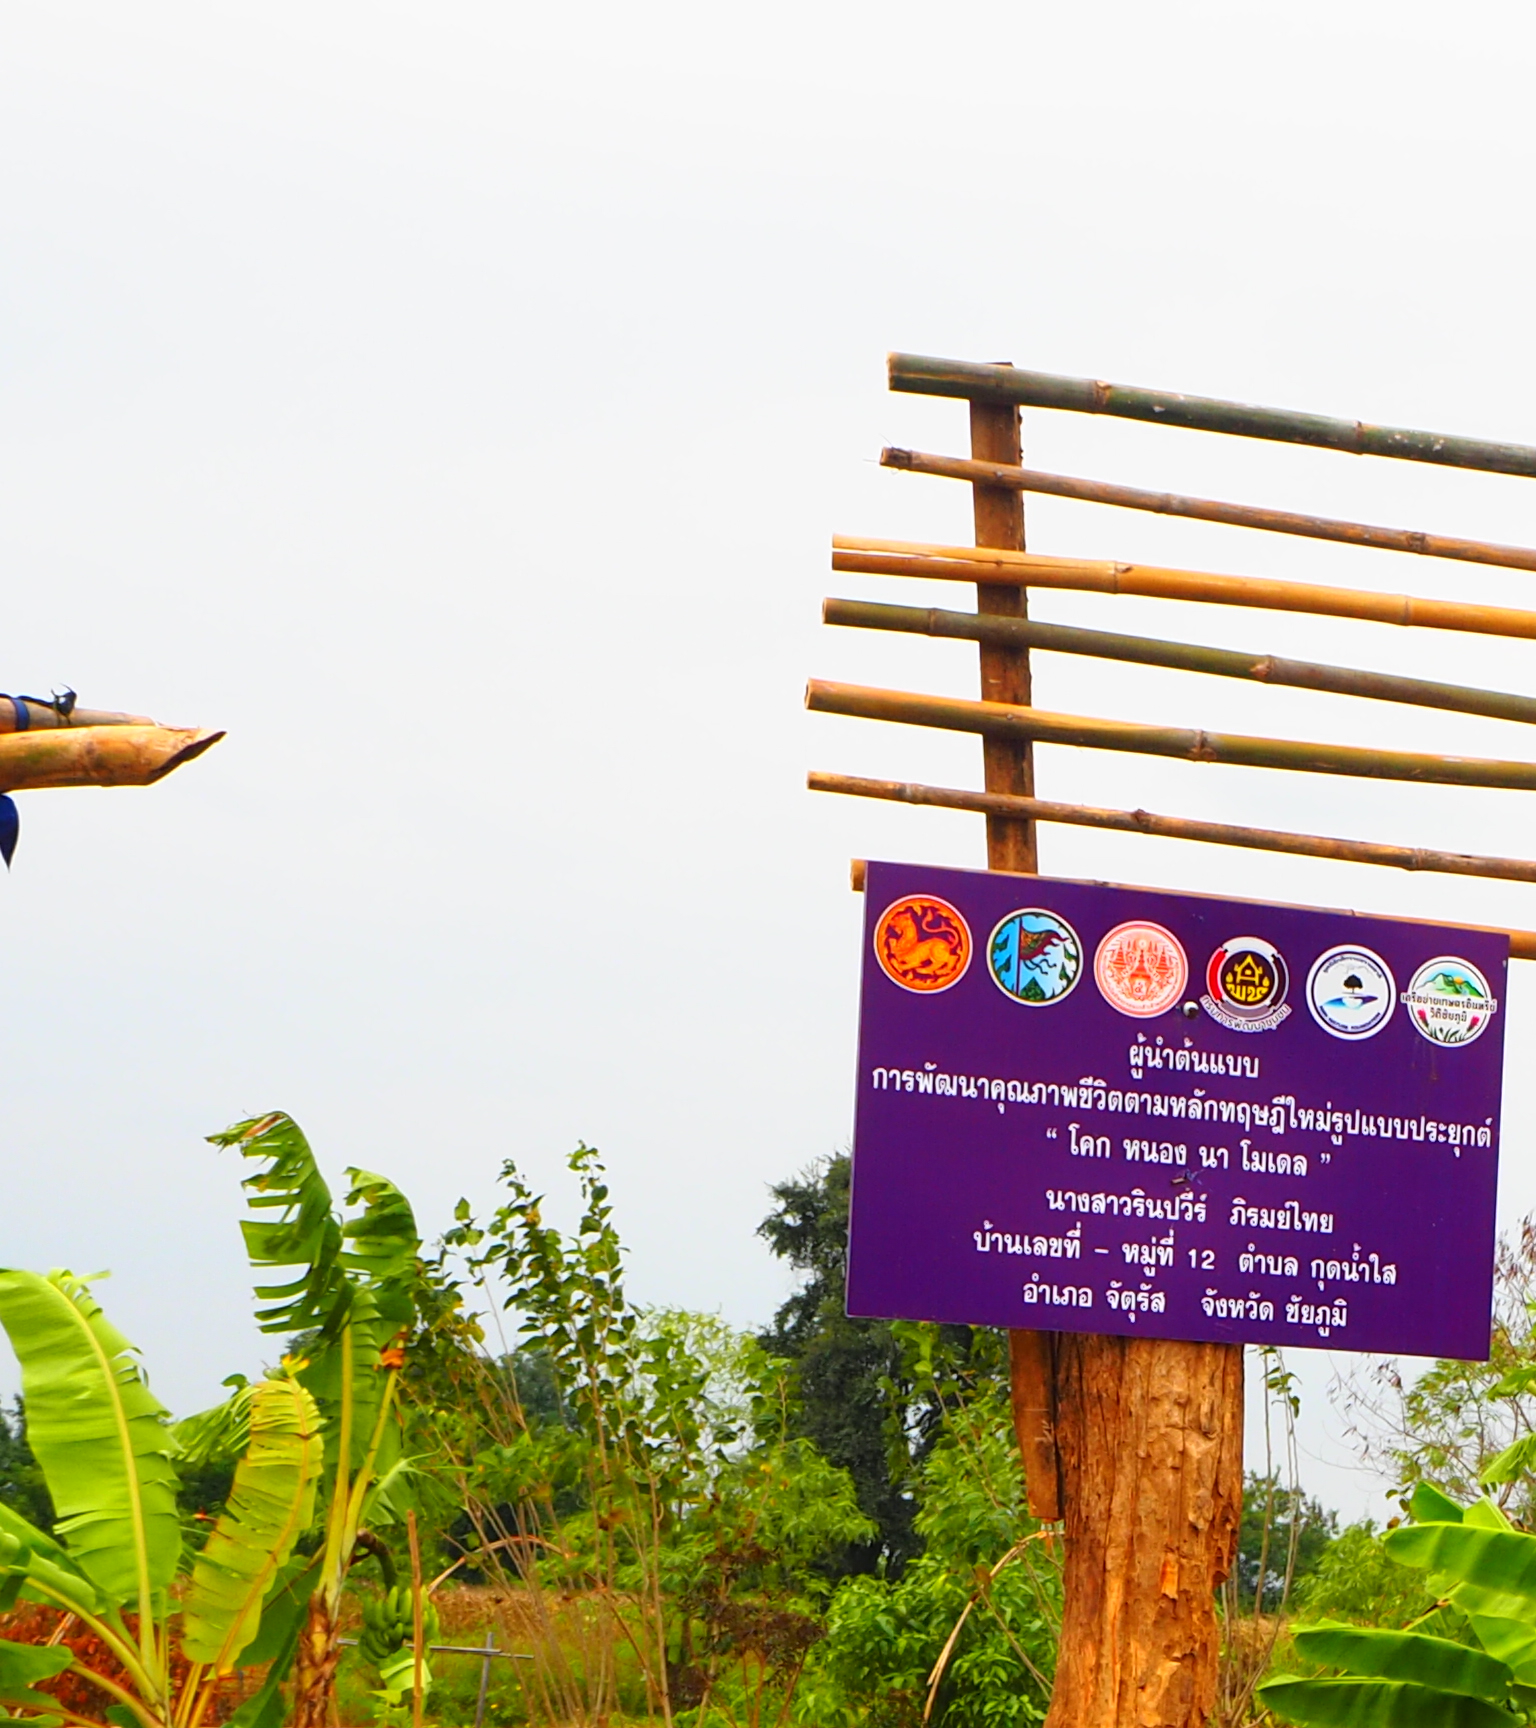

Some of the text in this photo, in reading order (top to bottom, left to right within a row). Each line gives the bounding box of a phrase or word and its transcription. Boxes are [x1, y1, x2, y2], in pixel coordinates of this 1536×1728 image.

[1128, 1035, 1260, 1080] ผู้นำต้นแบบ
[871, 1061, 1494, 1158] การพัฒนาคุณภาพชีวิตตามหลักทฤษฎีใหม่รูปแบบประยุกต์
[1068, 1123, 1111, 1159] โคก
[1122, 1137, 1188, 1166] หนอง
[1199, 1144, 1229, 1170] นา
[1240, 1139, 1308, 1177] โมเดล
[1045, 1187, 1335, 1234] นางสาวรินปวีร์ ภิรมย์ไทย
[973, 1220, 1081, 1259] บ้านเลขที่
[1121, 1228, 1174, 1277] หมู่ที่
[1187, 1248, 1216, 1270] 12
[1238, 1242, 1299, 1277] ตำบล
[1310, 1242, 1397, 1291] กุดน้ำใส
[1023, 1272, 1348, 1337] อำเภอ จัตุรัส จังหวัด ชัยภูมิ
